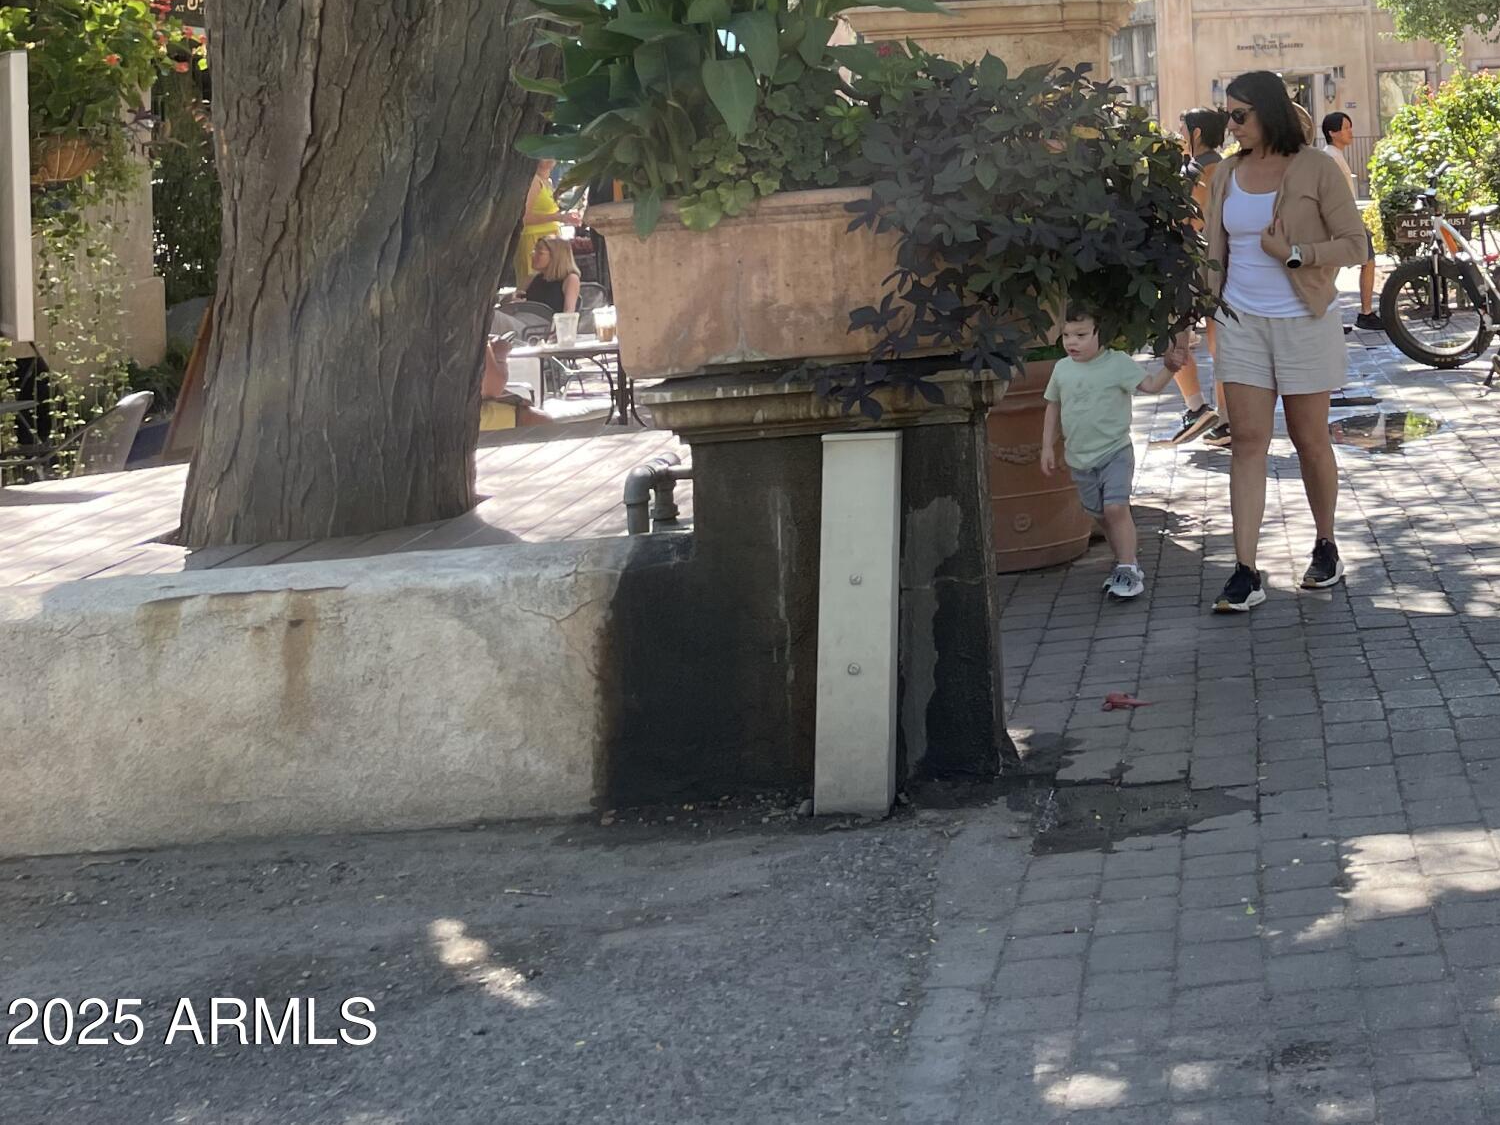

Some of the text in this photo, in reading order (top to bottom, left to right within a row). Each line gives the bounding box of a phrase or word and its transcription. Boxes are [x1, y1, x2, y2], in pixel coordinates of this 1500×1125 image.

[175, 4, 185, 12] AT
[1401, 220, 1416, 228] ALL
[1420, 219, 1434, 227] PET
[1408, 230, 1418, 238] BE
